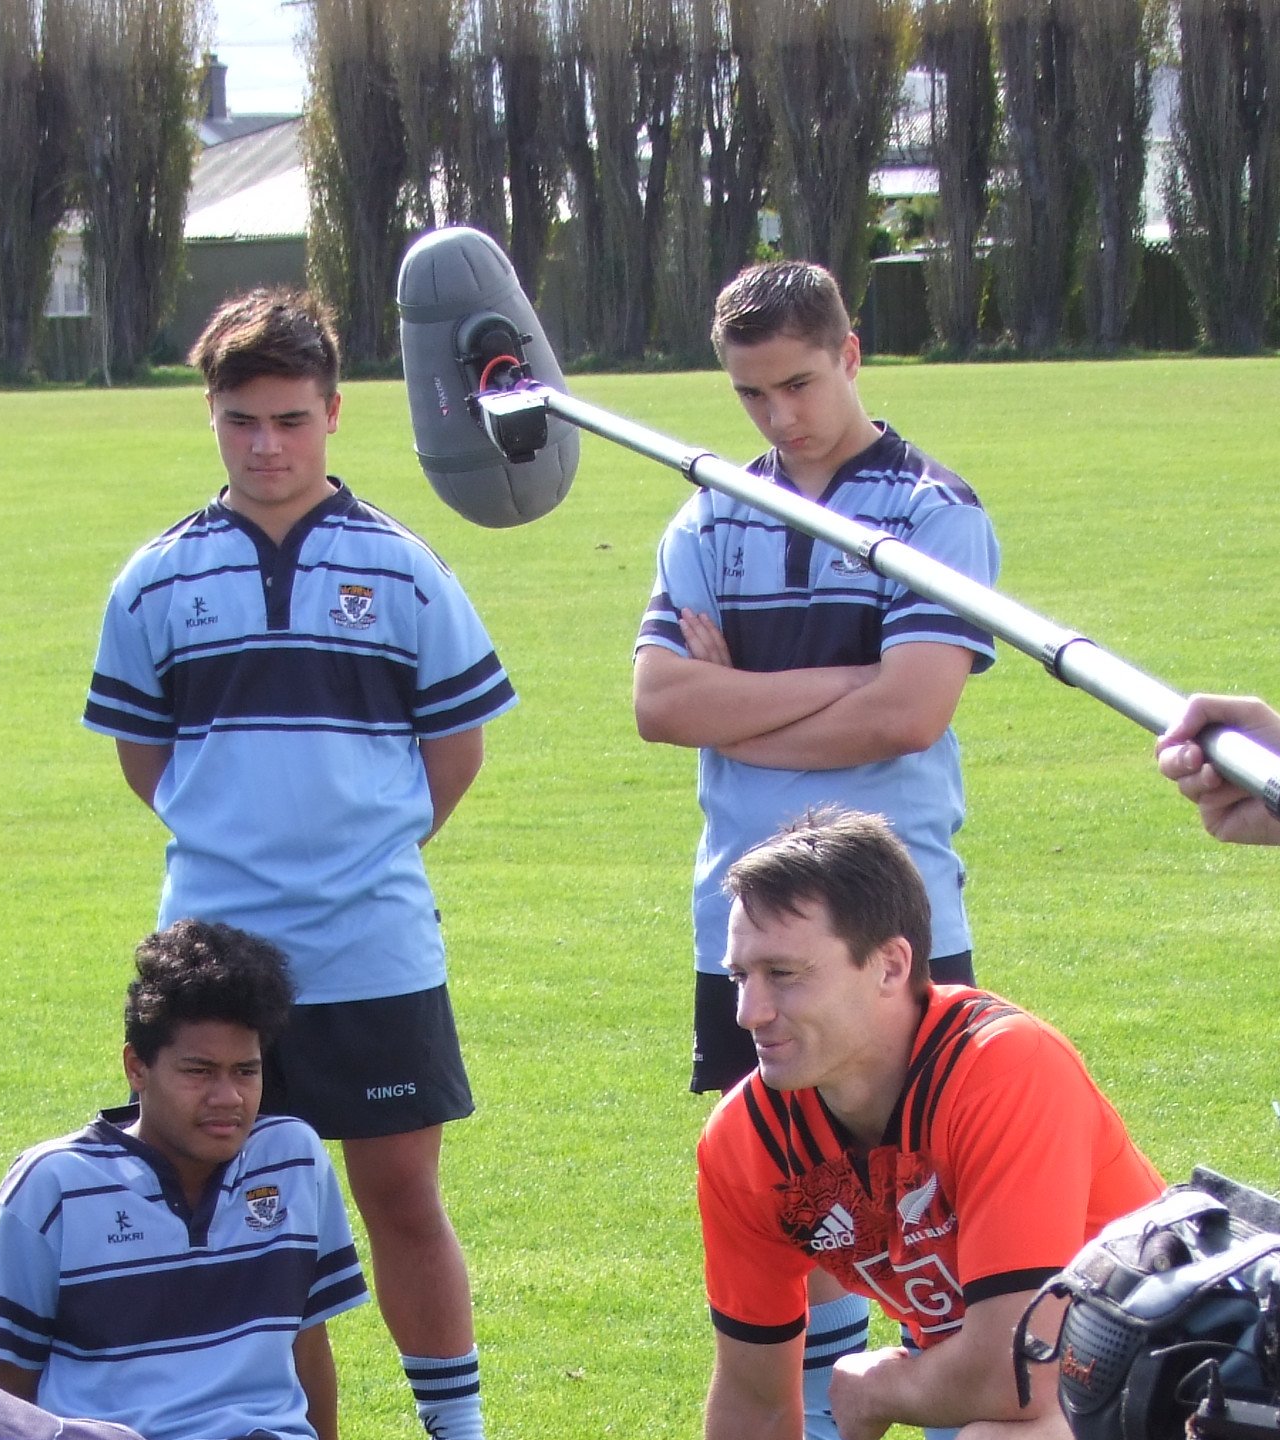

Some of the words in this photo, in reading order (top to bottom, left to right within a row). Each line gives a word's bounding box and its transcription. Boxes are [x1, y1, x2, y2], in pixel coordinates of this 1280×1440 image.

[185, 615, 219, 628] KUKRI
[366, 1082, 417, 1100] KING'S
[107, 1232, 145, 1244] KUKRI
[904, 1231, 926, 1246] ALL
